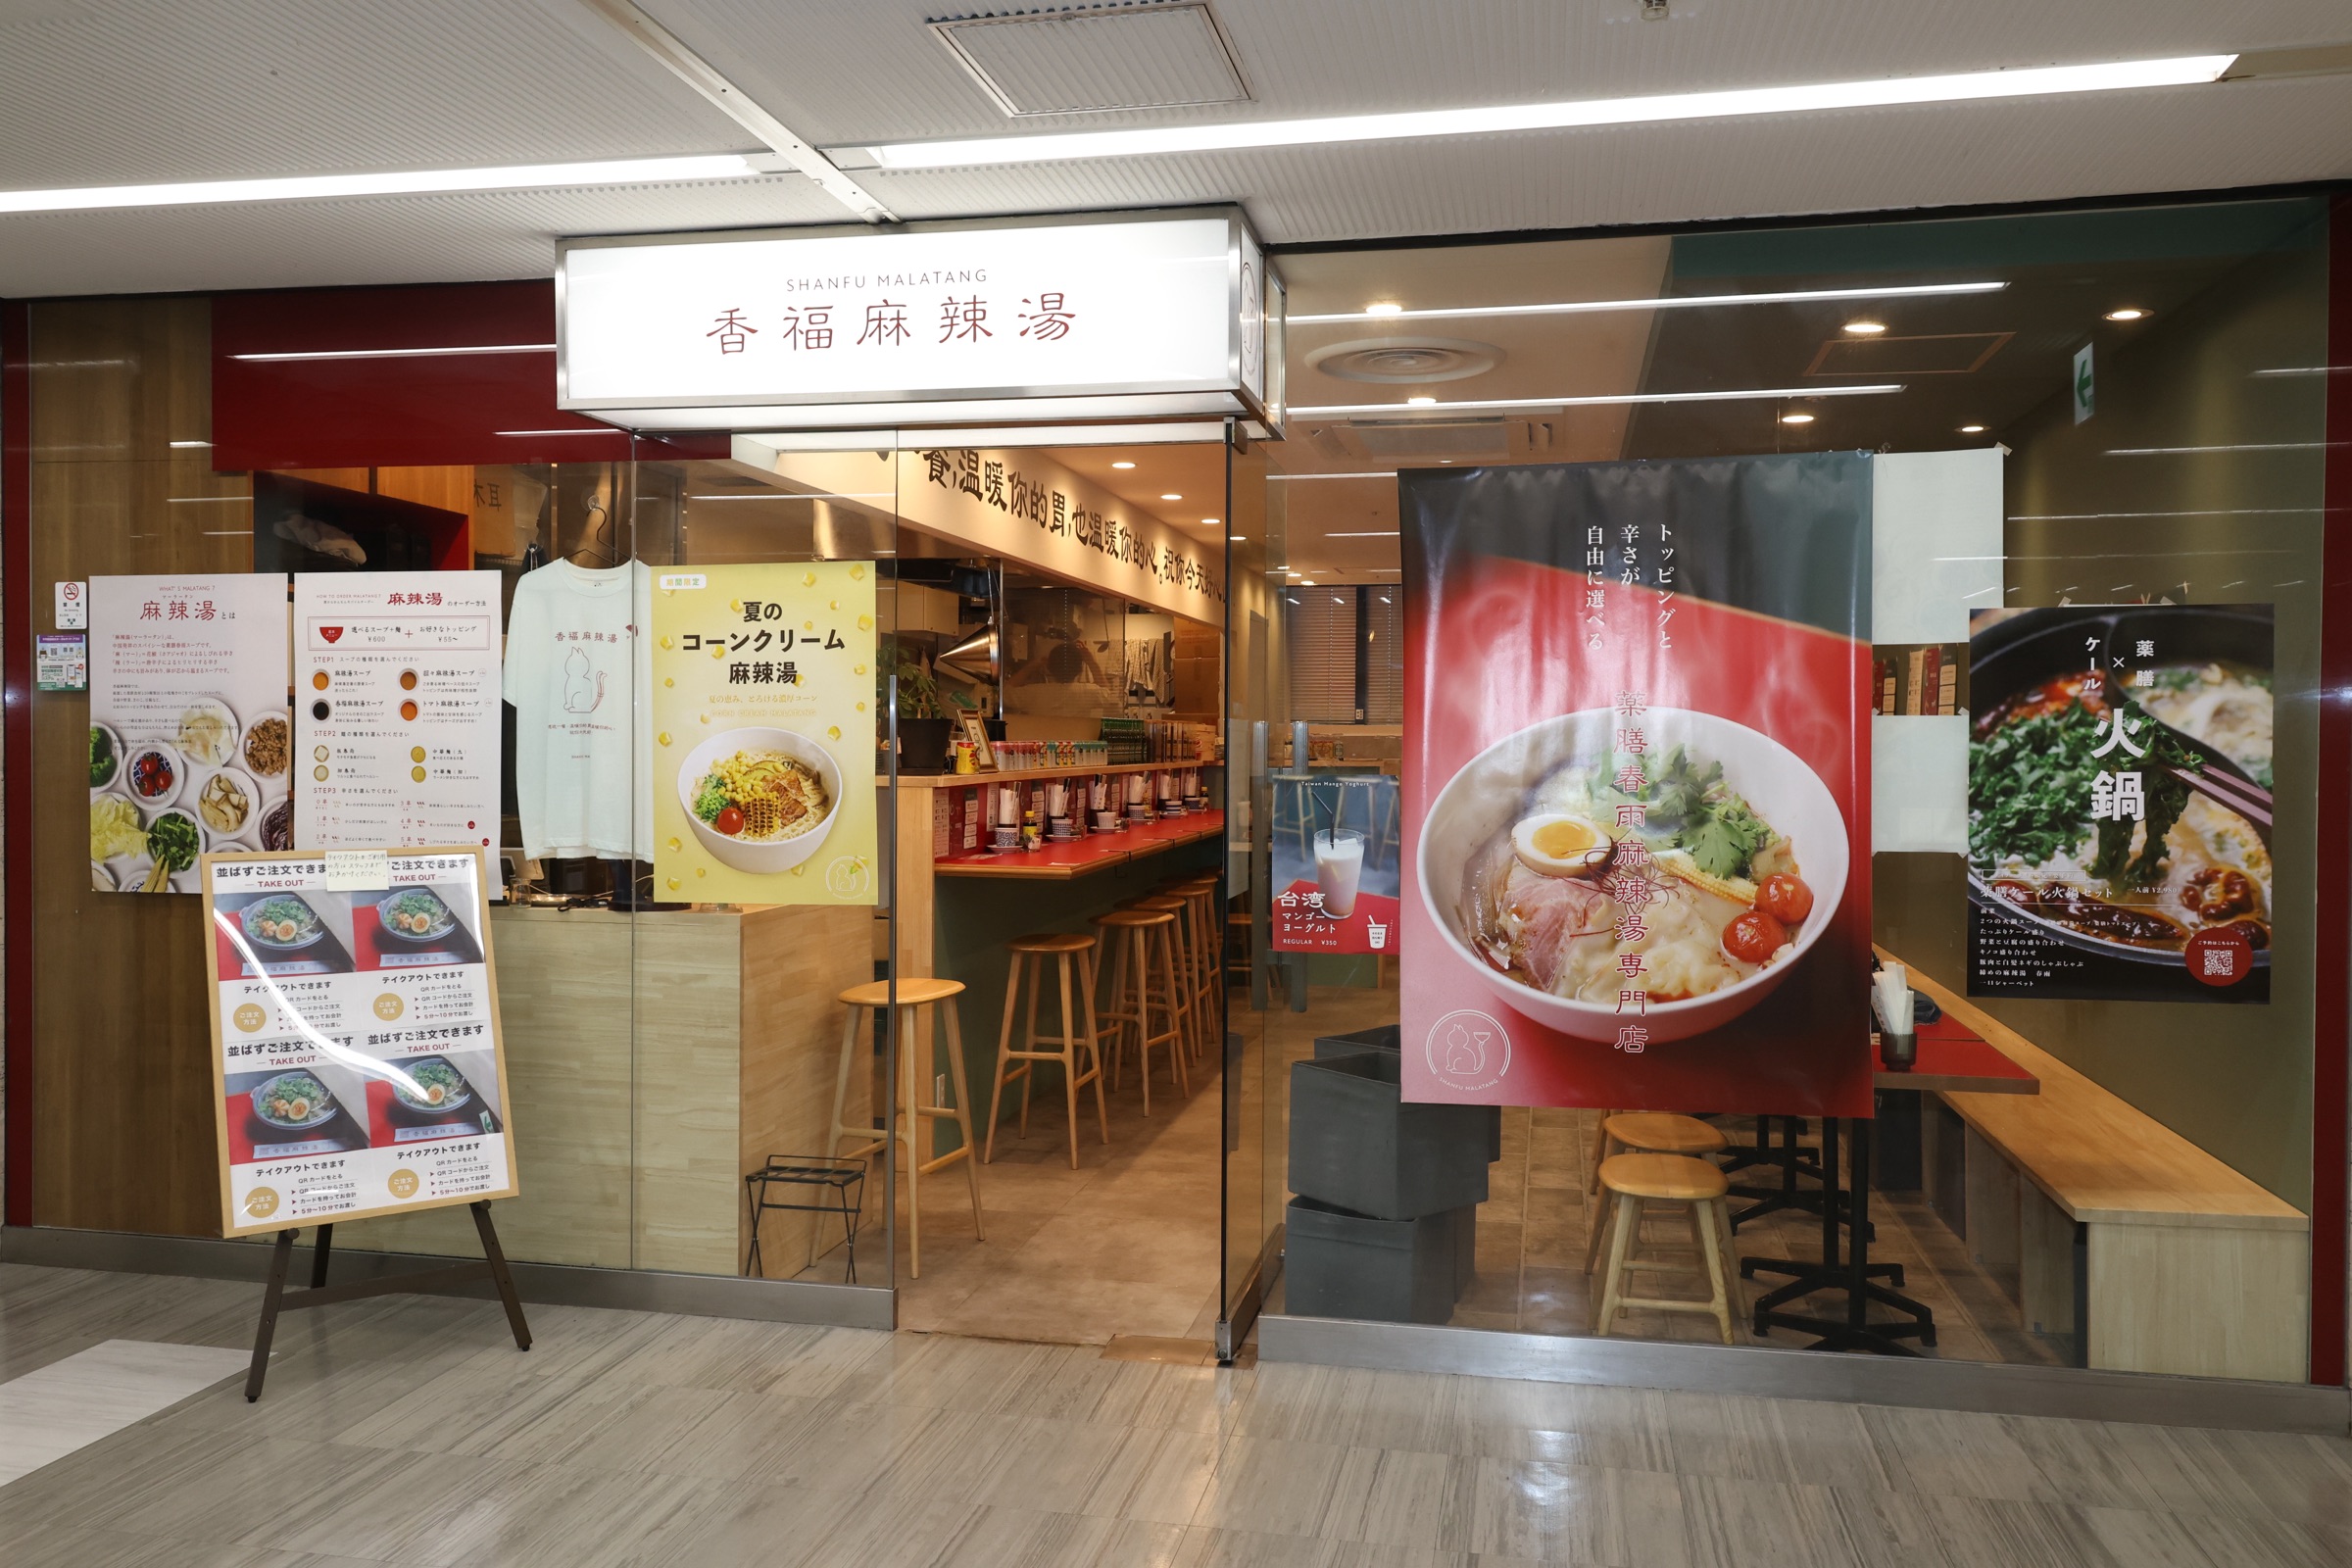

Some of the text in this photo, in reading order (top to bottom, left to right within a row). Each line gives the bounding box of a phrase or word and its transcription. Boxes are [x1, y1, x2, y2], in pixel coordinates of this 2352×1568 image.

[786, 269, 988, 292] SHANFU MALATANG
[706, 292, 1076, 356] 香福麻辣湯
[1620, 524, 1641, 586] 辛さが
[666, 577, 700, 587] 期間限定
[1586, 525, 1605, 650] 自由に選べる
[1657, 523, 1676, 649] トッピングと
[387, 592, 443, 607] 麻辣湯
[139, 600, 217, 621] 麻辣湯
[743, 601, 783, 622] 夏の
[555, 631, 617, 643] 香福麻辣湯
[683, 628, 846, 653] コーンクリーム
[2083, 637, 2101, 691] ケール
[2135, 640, 2155, 688] 薬膳
[728, 662, 798, 685] 麻辣湯
[2090, 708, 2146, 821] 火鍋
[217, 863, 326, 878] 並ばずご注文できま
[1613, 690, 1649, 1054] 薬膳春雨麻辣湯専門店
[1277, 891, 1325, 908] 台湾
[1980, 885, 2113, 899] 薬膳ケール火鍋セット
[1282, 911, 1325, 920] マンゴー
[1283, 923, 1336, 933] ヨーグルト
[381, 971, 465, 984] テイクアウトできます
[244, 981, 332, 994] テイクウトできます
[422, 1002, 473, 1010] カードを持ってお会計
[368, 1024, 484, 1045] 並ばずご注文できます
[1439, 1077, 1498, 1091] SHANFU MALATANG
[397, 1143, 480, 1159] テイクアウトできます
[256, 1159, 346, 1177] テイクアウトできます
[447, 1156, 478, 1165] カードをとる
[438, 1174, 491, 1186] カードを持ってお会計
[252, 1195, 272, 1203] ご注文
[300, 1193, 357, 1204] カードを持ってお会計
